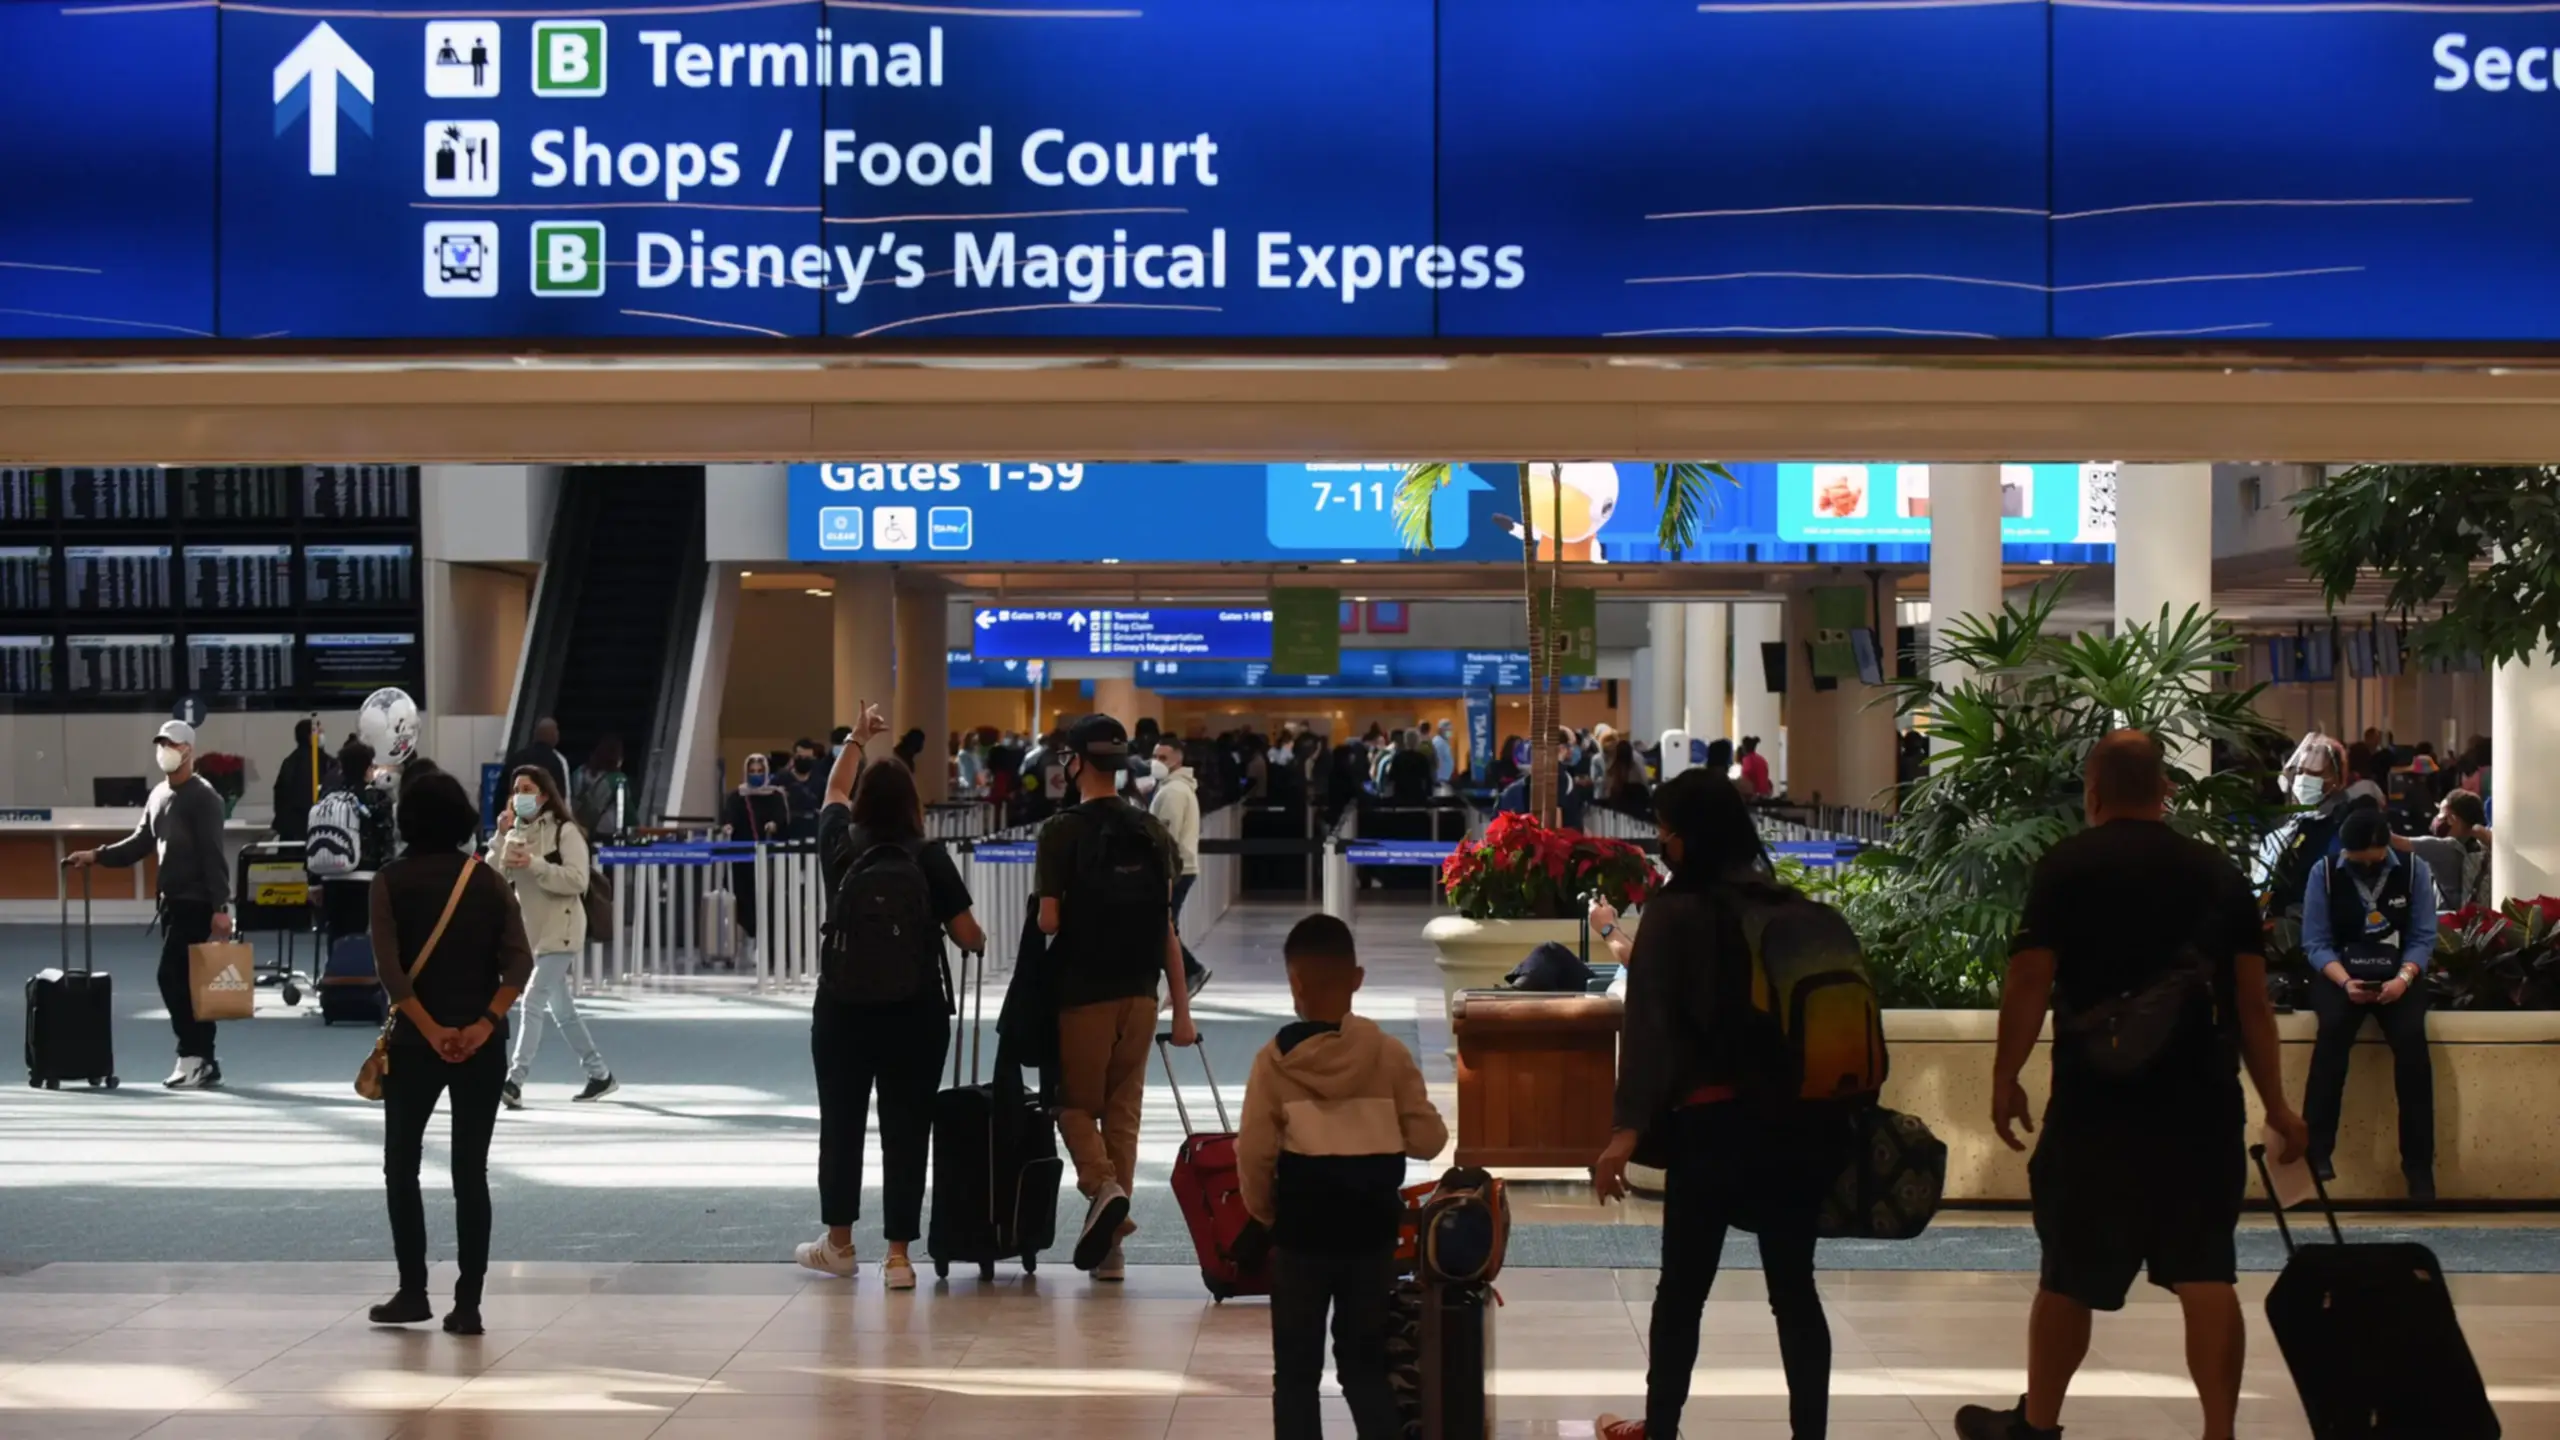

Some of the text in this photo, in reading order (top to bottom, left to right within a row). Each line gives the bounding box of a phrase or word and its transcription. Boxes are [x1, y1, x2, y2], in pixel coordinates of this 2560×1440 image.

[550, 27, 944, 87] B Terminal
[531, 126, 1218, 201] Shops / Food Court
[549, 234, 587, 283] B
[954, 228, 1226, 303] Magical
[1258, 232, 1524, 303] Express
[820, 462, 1084, 491] Gates 1-59
[1311, 481, 1383, 511] 7-11
[1114, 611, 1149, 620] Terminal
[2350, 957, 2392, 966] NAUTICA
